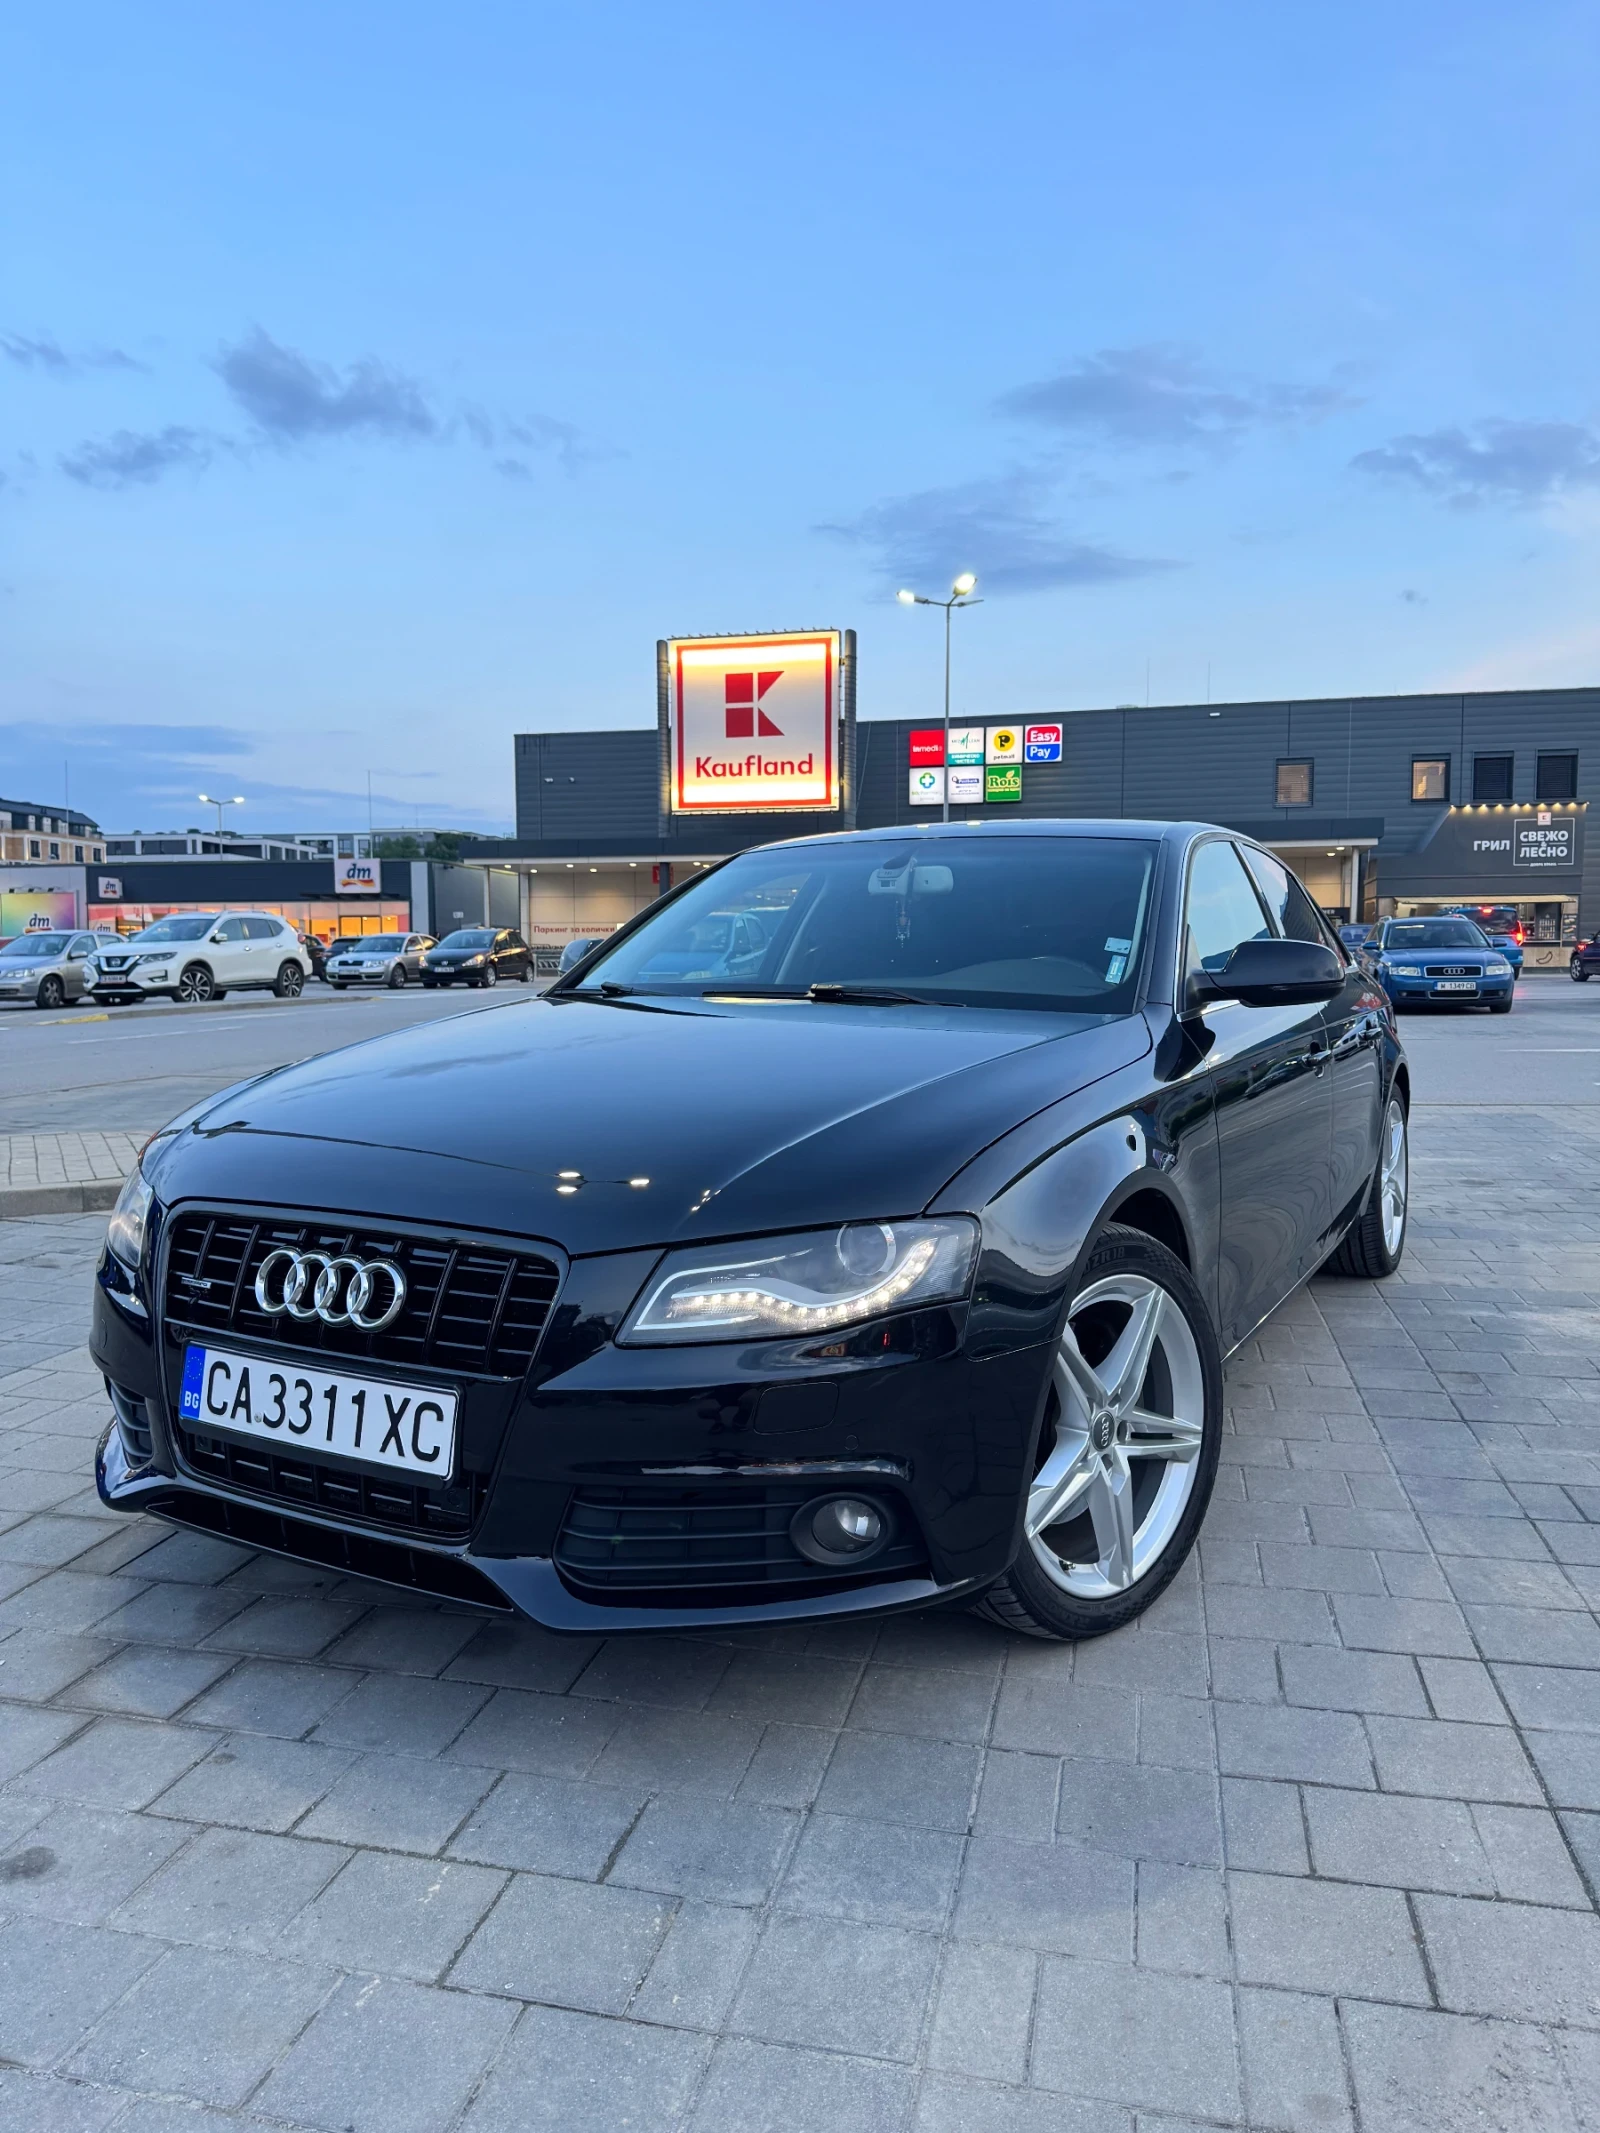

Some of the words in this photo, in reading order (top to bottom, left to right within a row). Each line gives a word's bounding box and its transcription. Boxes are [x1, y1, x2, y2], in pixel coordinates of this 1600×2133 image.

[1030, 730, 1057, 743] Easy
[1030, 746, 1051, 758] Pay
[696, 753, 813, 778] Kaufland
[989, 776, 1019, 787] Rois
[1519, 830, 1569, 842] СВЕЖО
[1473, 840, 1510, 851] ГРИЛ
[1519, 846, 1568, 858] ЛЕСНО
[346, 863, 371, 879] dm
[105, 881, 116, 890] dm
[29, 913, 50, 928] dm
[97, 923, 111, 932] dm
[533, 925, 568, 935] Паркинг
[184, 1390, 200, 1409] BG
